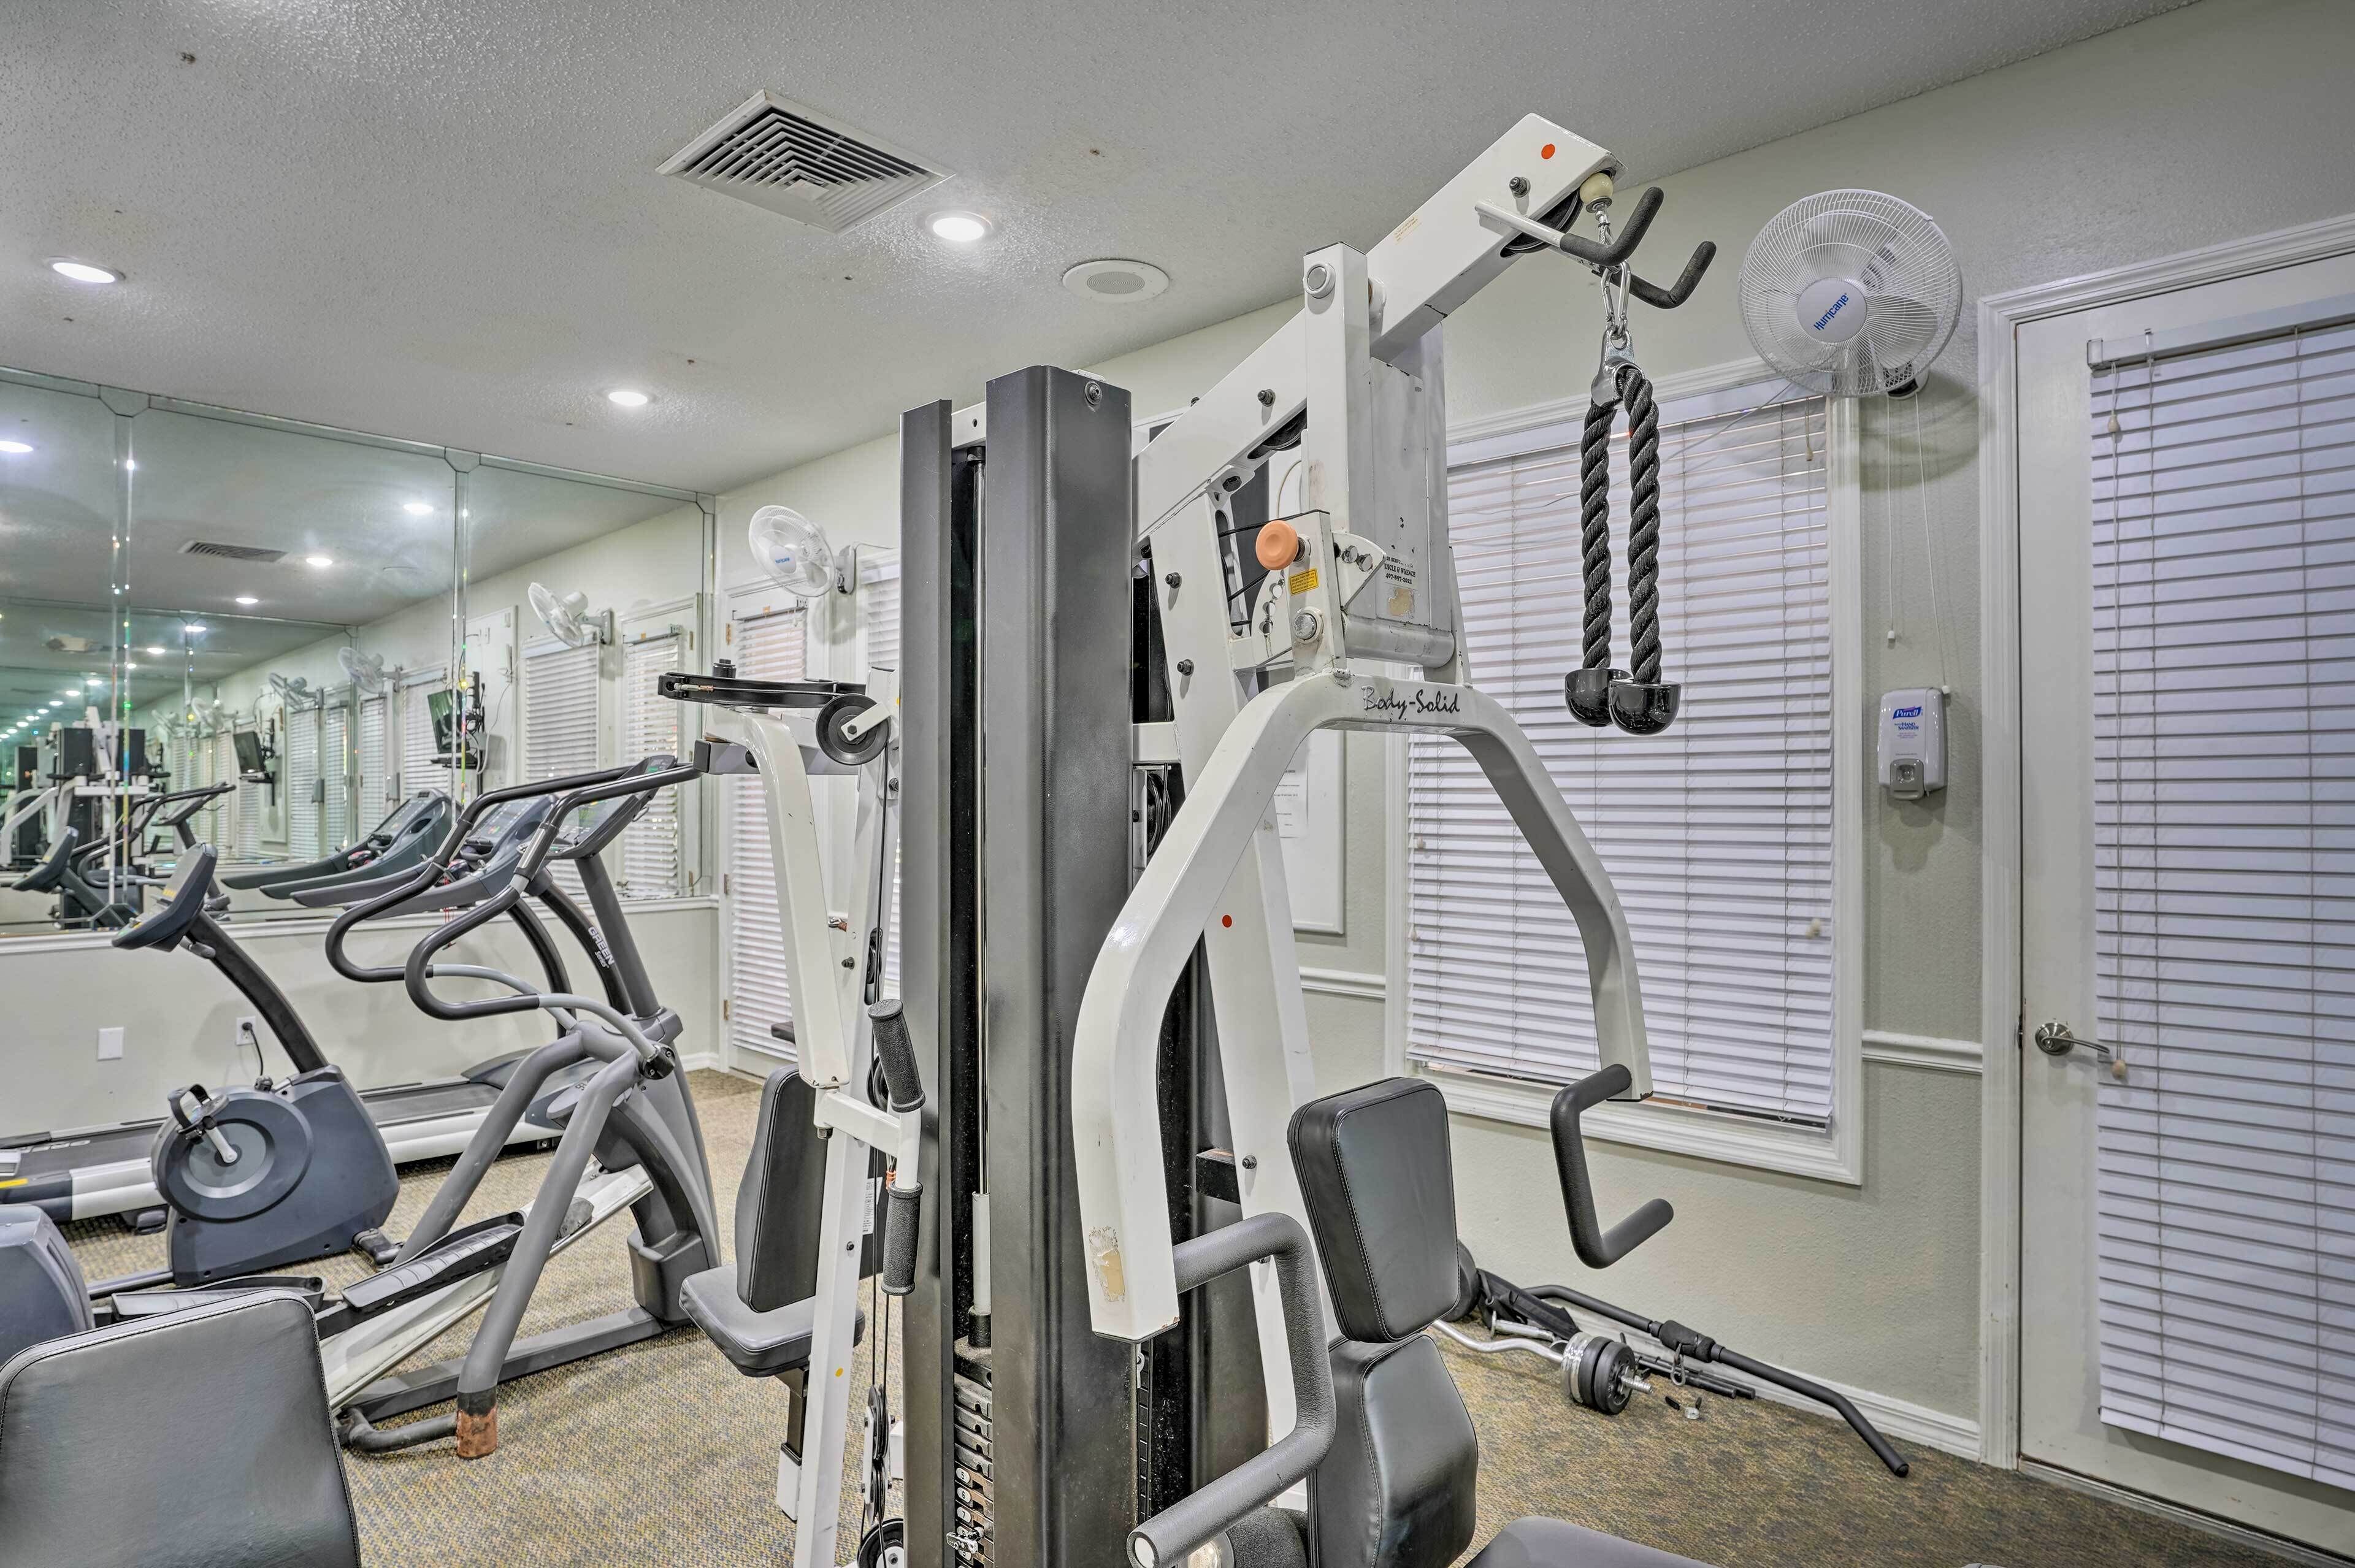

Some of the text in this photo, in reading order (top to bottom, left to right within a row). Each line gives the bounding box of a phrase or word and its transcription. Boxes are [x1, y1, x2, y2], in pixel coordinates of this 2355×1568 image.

[1813, 294, 1849, 331] Hurricane
[1384, 563, 1396, 572] USCLE
[1361, 685, 1460, 720] Body-Solid
[588, 926, 615, 966] GREEN
[961, 1471, 965, 1480] 5
[962, 1491, 966, 1499] 6
[962, 1510, 965, 1519] 7
